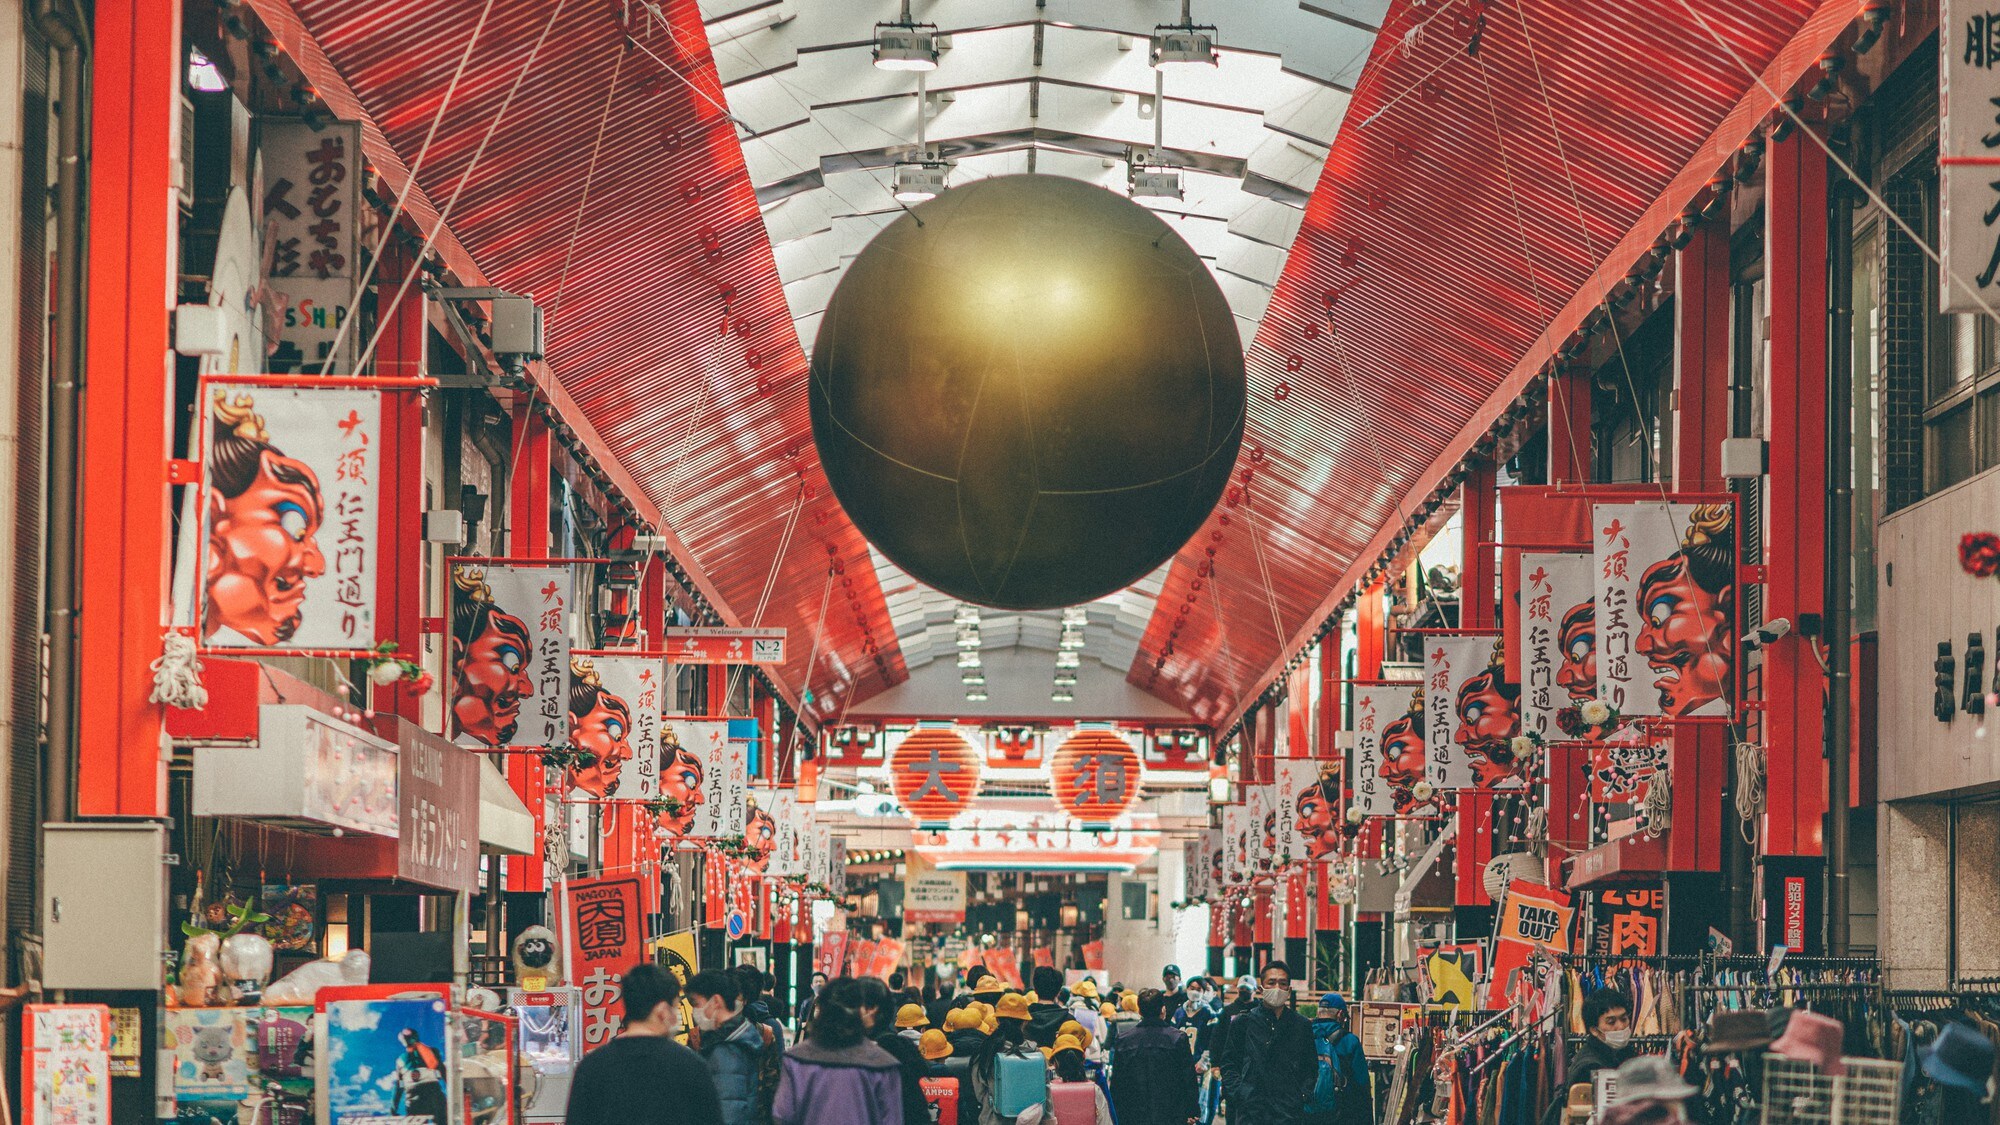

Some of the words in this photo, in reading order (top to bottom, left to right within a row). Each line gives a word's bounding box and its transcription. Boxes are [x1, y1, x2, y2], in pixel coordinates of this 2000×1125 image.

[335, 409, 370, 640] 大須仁王門通り
[755, 640, 781, 652] N-2
[1527, 566, 1556, 737] 大須仁王門通り
[1602, 517, 1634, 710] 大須仁王門通り
[539, 580, 565, 742] 大須仁王門通り
[636, 669, 658, 795] 大須仁王門通り
[1358, 694, 1378, 811] 大須仁王門通り
[1430, 646, 1452, 785] 大須仁王門通り
[708, 729, 725, 833] 大須仁王門通り
[908, 749, 961, 802] 大
[1073, 754, 1126, 806] 須
[576, 888, 623, 902] NAGOYA
[1517, 920, 1555, 943] OUT
[1518, 904, 1560, 925] TAKE
[1787, 882, 1802, 949] 防犯カメラ設置
[584, 948, 622, 961] JAPAN
